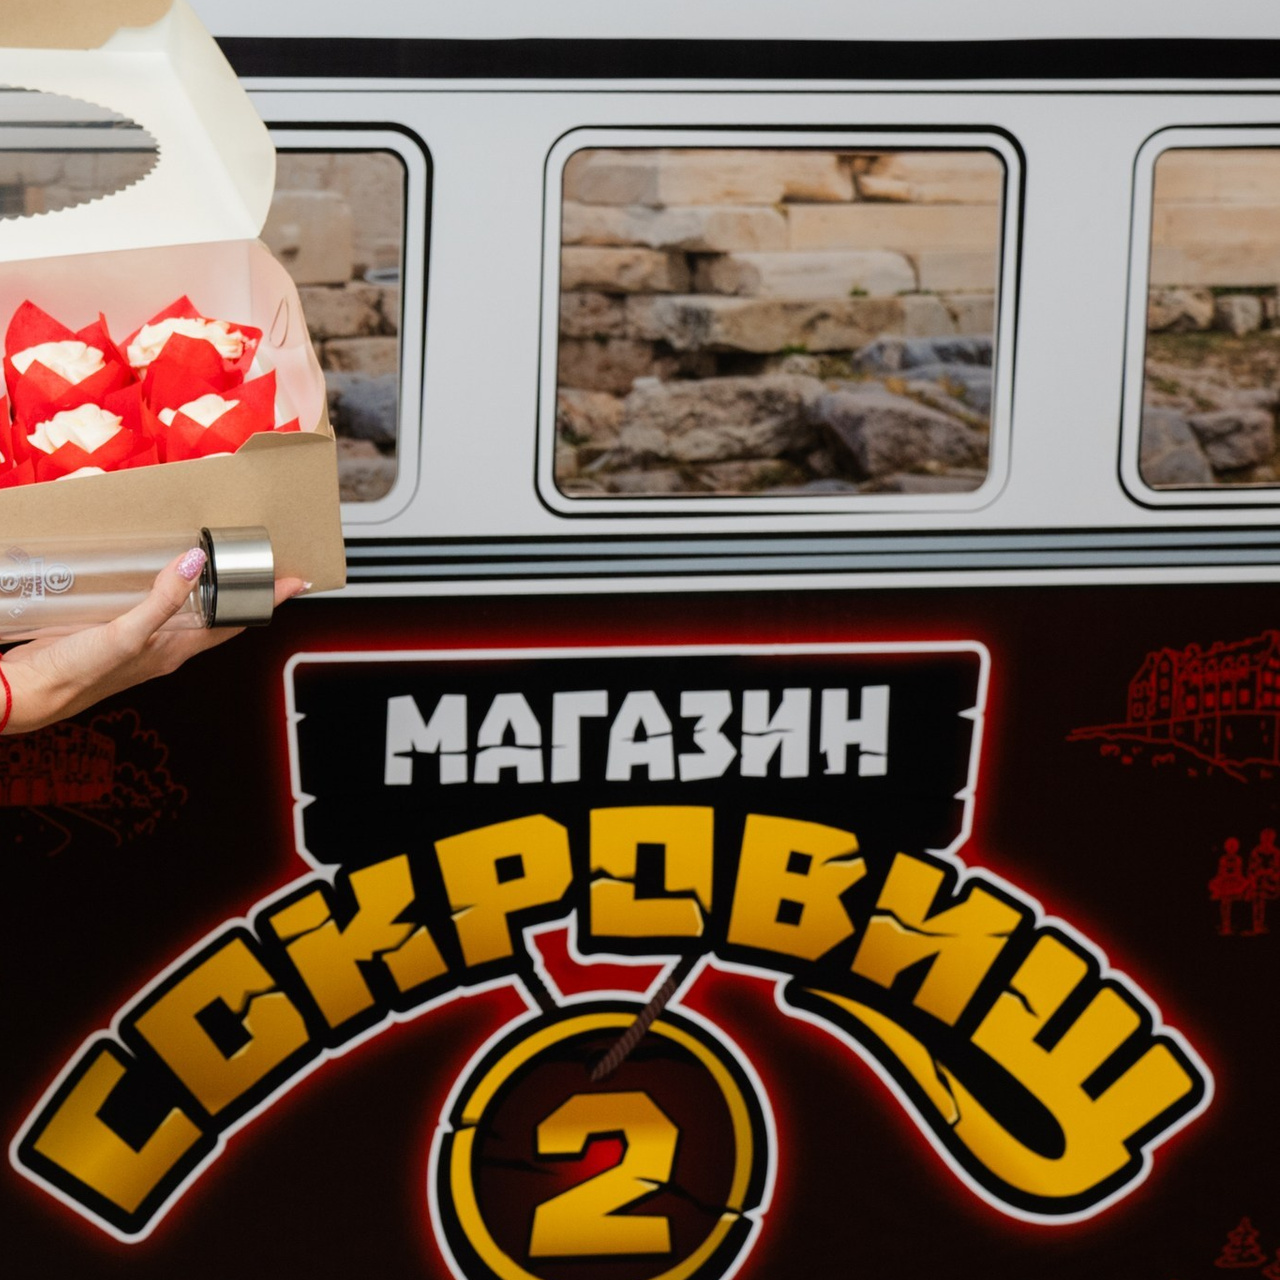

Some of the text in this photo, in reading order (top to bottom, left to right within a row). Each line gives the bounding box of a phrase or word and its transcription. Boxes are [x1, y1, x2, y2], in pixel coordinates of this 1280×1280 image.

[383, 684, 890, 786] МАГАЗИН
[31, 805, 1196, 1216] СОКРОВИЩ
[527, 1090, 679, 1259] 2
